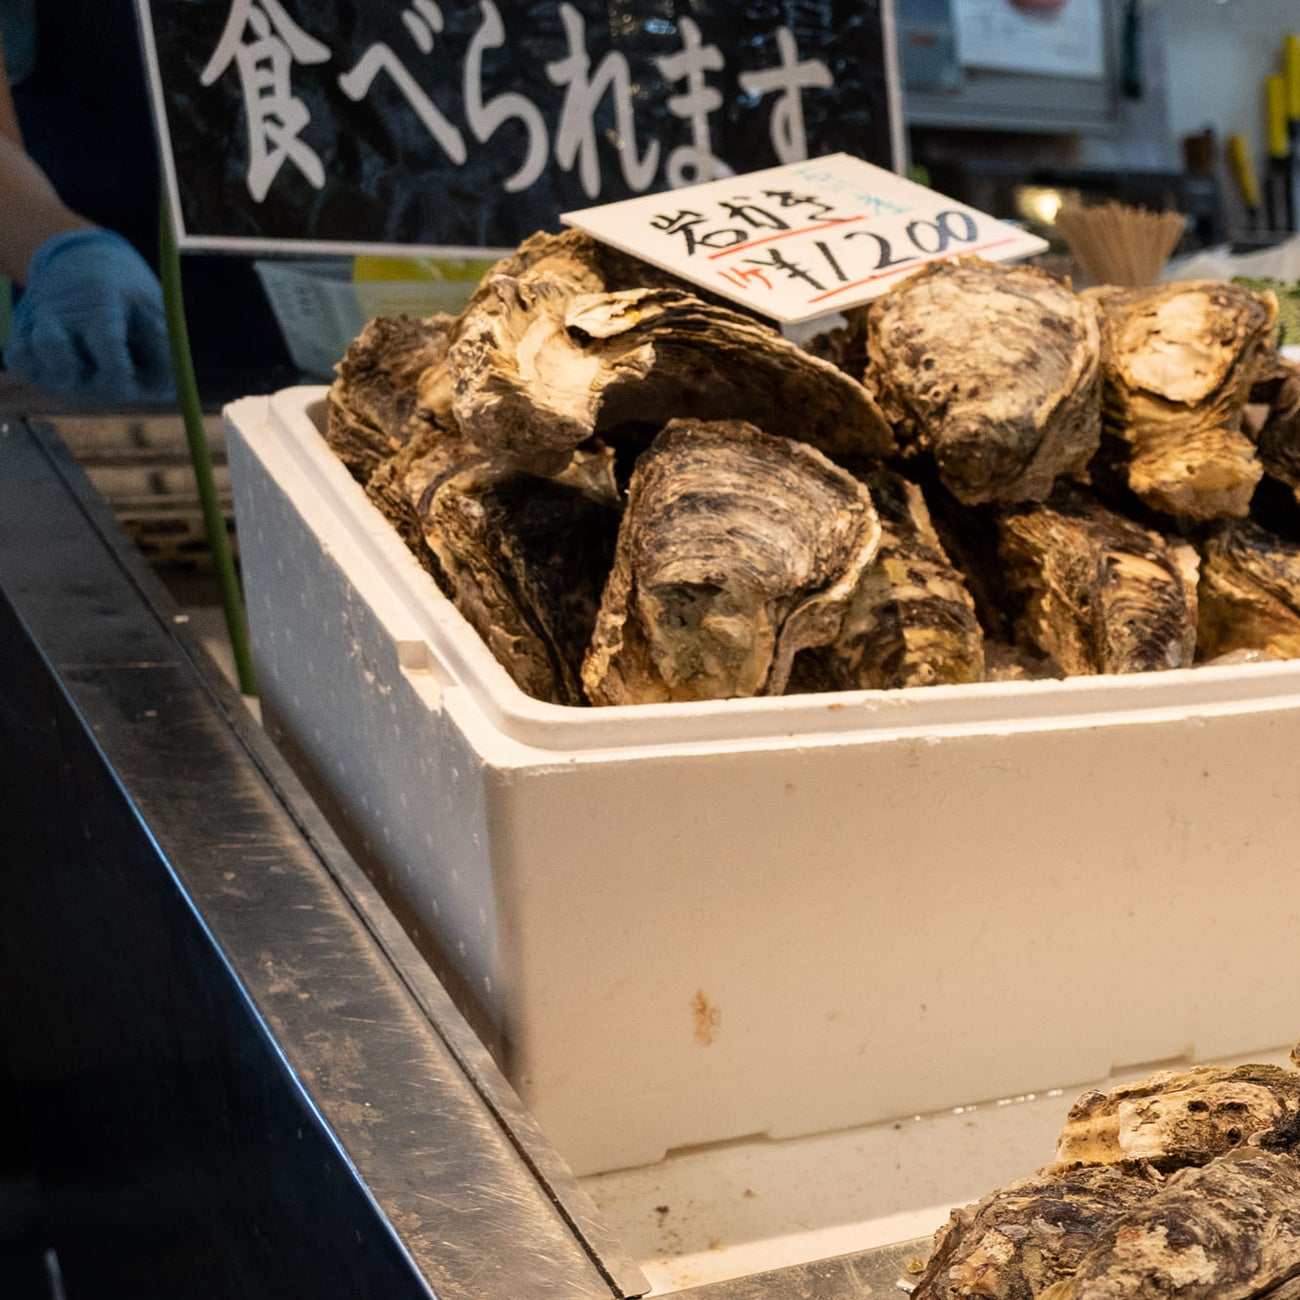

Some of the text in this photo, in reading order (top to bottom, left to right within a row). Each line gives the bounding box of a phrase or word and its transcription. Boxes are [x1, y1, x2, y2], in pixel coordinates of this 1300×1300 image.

[200, 0, 834, 201] 食べられます
[650, 189, 841, 257] 岩かき
[748, 210, 978, 291] ¥1200
